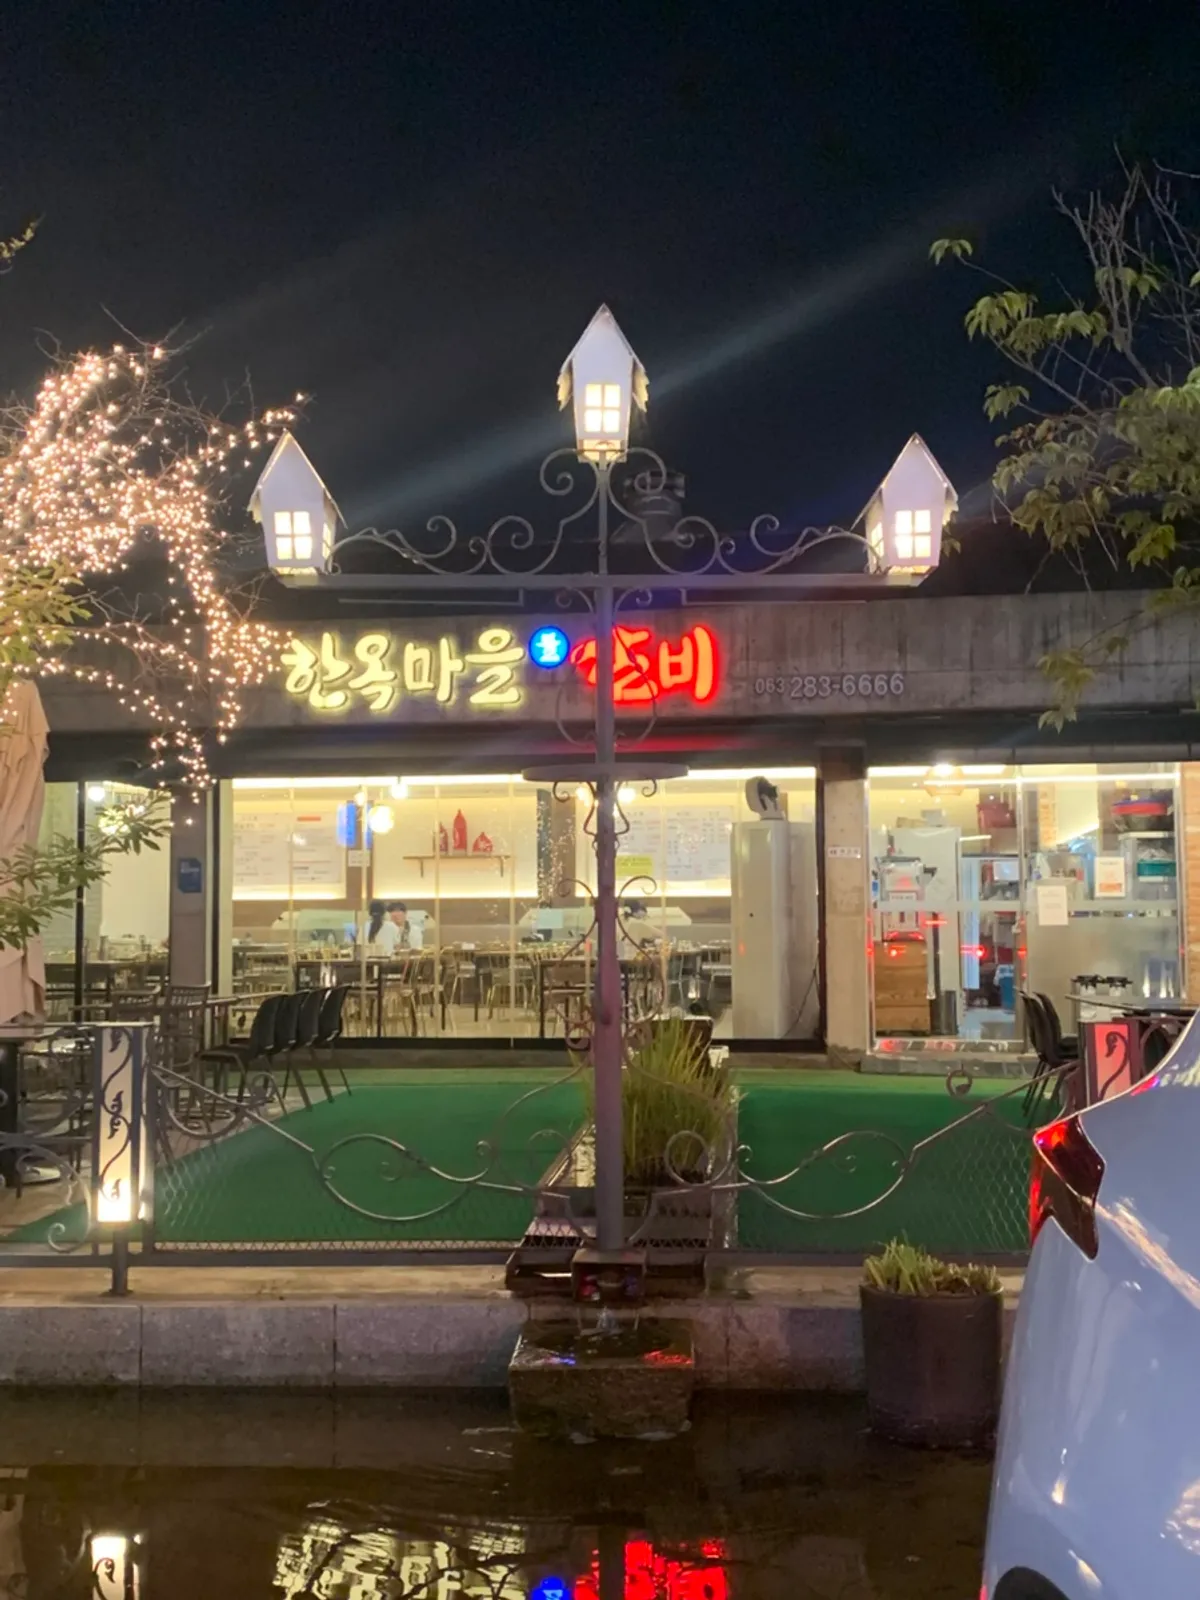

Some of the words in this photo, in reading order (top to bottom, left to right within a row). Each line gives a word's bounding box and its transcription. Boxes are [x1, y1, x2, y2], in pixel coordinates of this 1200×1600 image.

[280, 627, 526, 711] 한옥마을
[754, 677, 786, 695] 063
[789, 672, 906, 699] 283-6666
